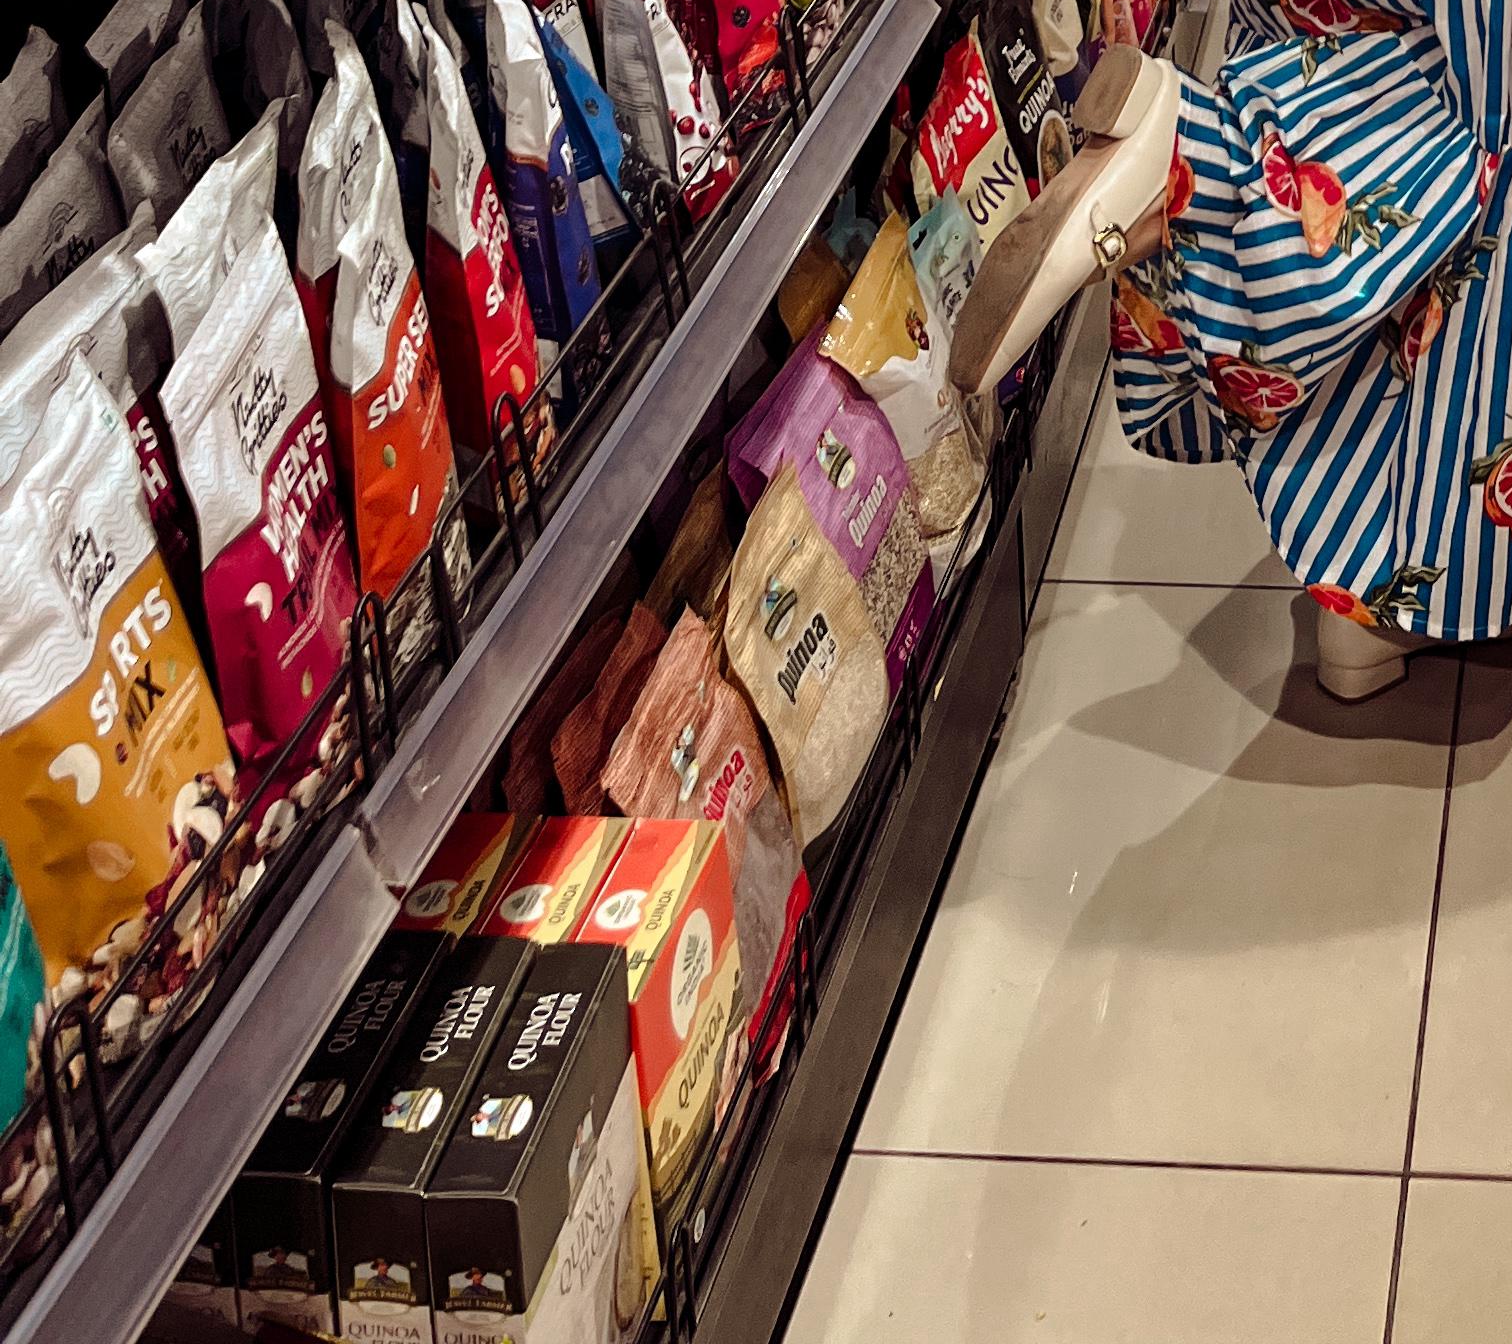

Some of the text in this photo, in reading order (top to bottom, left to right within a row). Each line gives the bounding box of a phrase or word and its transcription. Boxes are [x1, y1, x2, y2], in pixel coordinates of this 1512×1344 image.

[1019, 71, 1056, 134] QUINOA
[368, 333, 419, 430] SUPER
[454, 880, 485, 922] QUINOA
[549, 883, 581, 927] QUINOA
[646, 887, 675, 932] QUINOA
[421, 986, 474, 1064] QUINOA
[453, 984, 496, 1040] FLOUR
[508, 992, 561, 1070] QUINOA
[544, 992, 583, 1047] FLOUR
[678, 1004, 726, 1110] QUINOA
[348, 1321, 421, 1341] QUINOA
